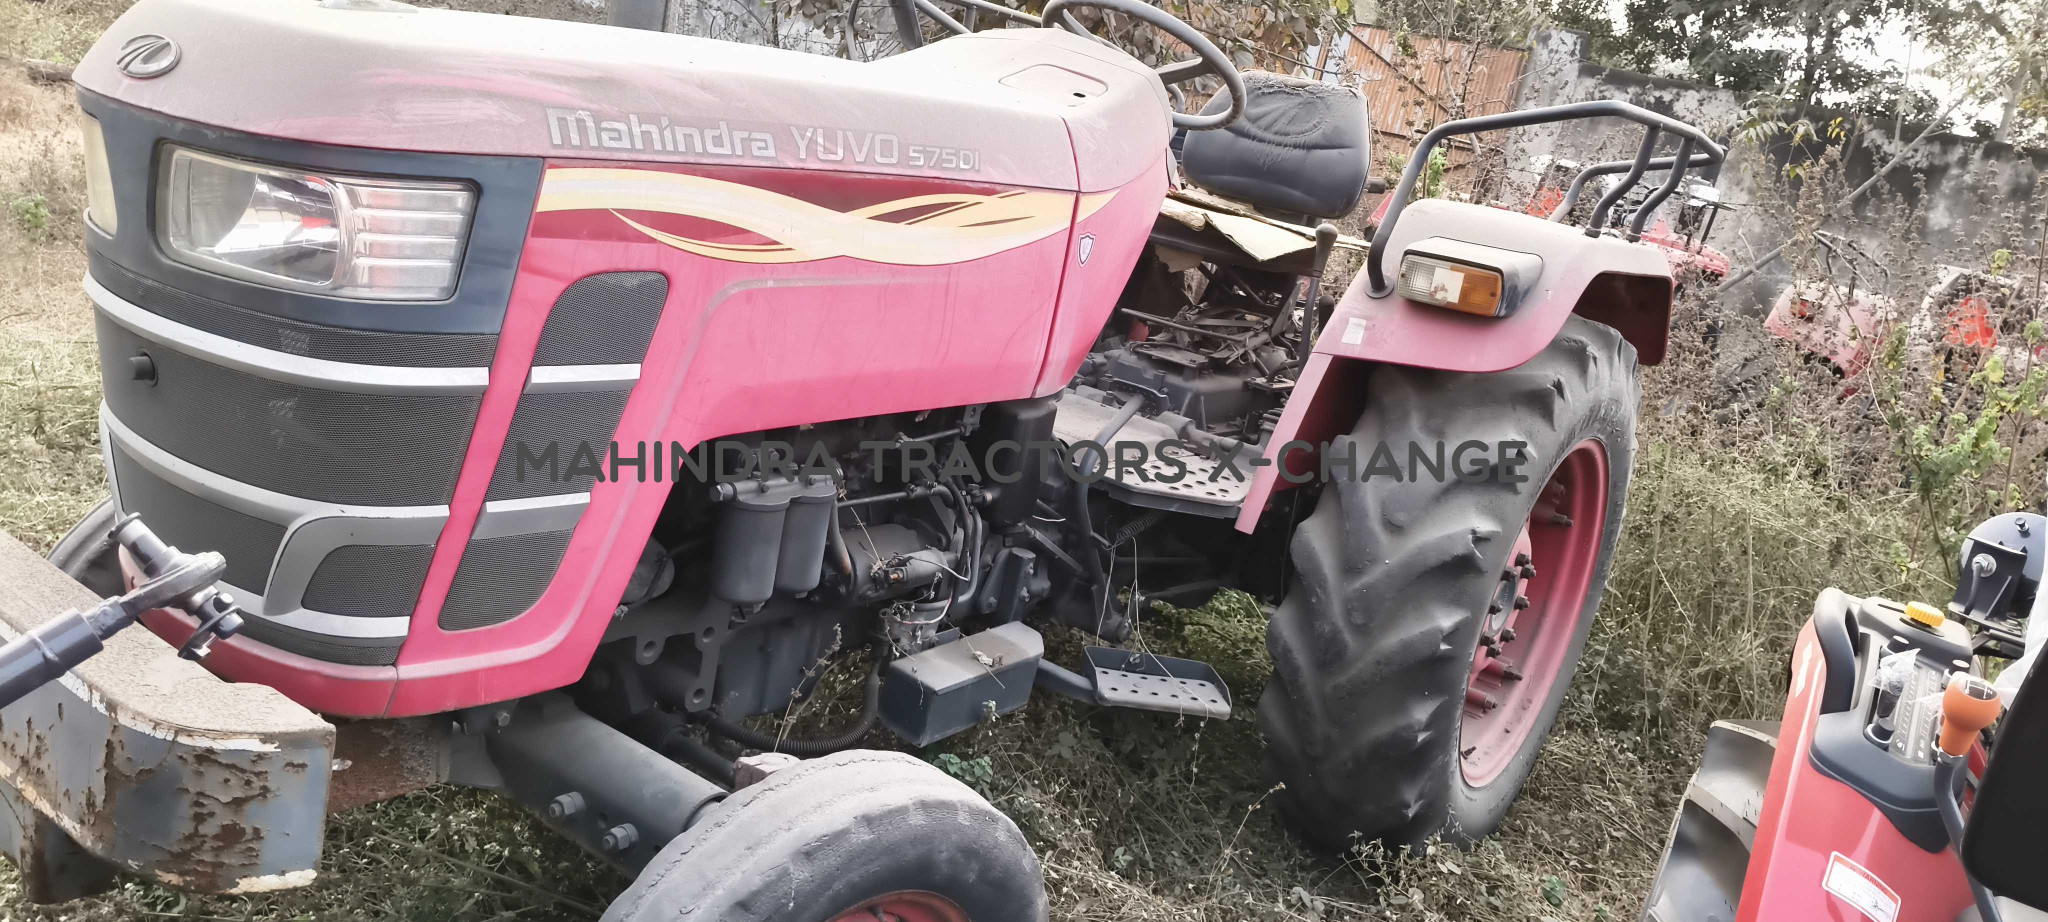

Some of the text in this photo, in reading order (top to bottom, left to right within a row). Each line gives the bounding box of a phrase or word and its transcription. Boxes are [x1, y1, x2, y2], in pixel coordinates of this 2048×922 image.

[545, 107, 980, 170] Mahindra YUVO 575DI
